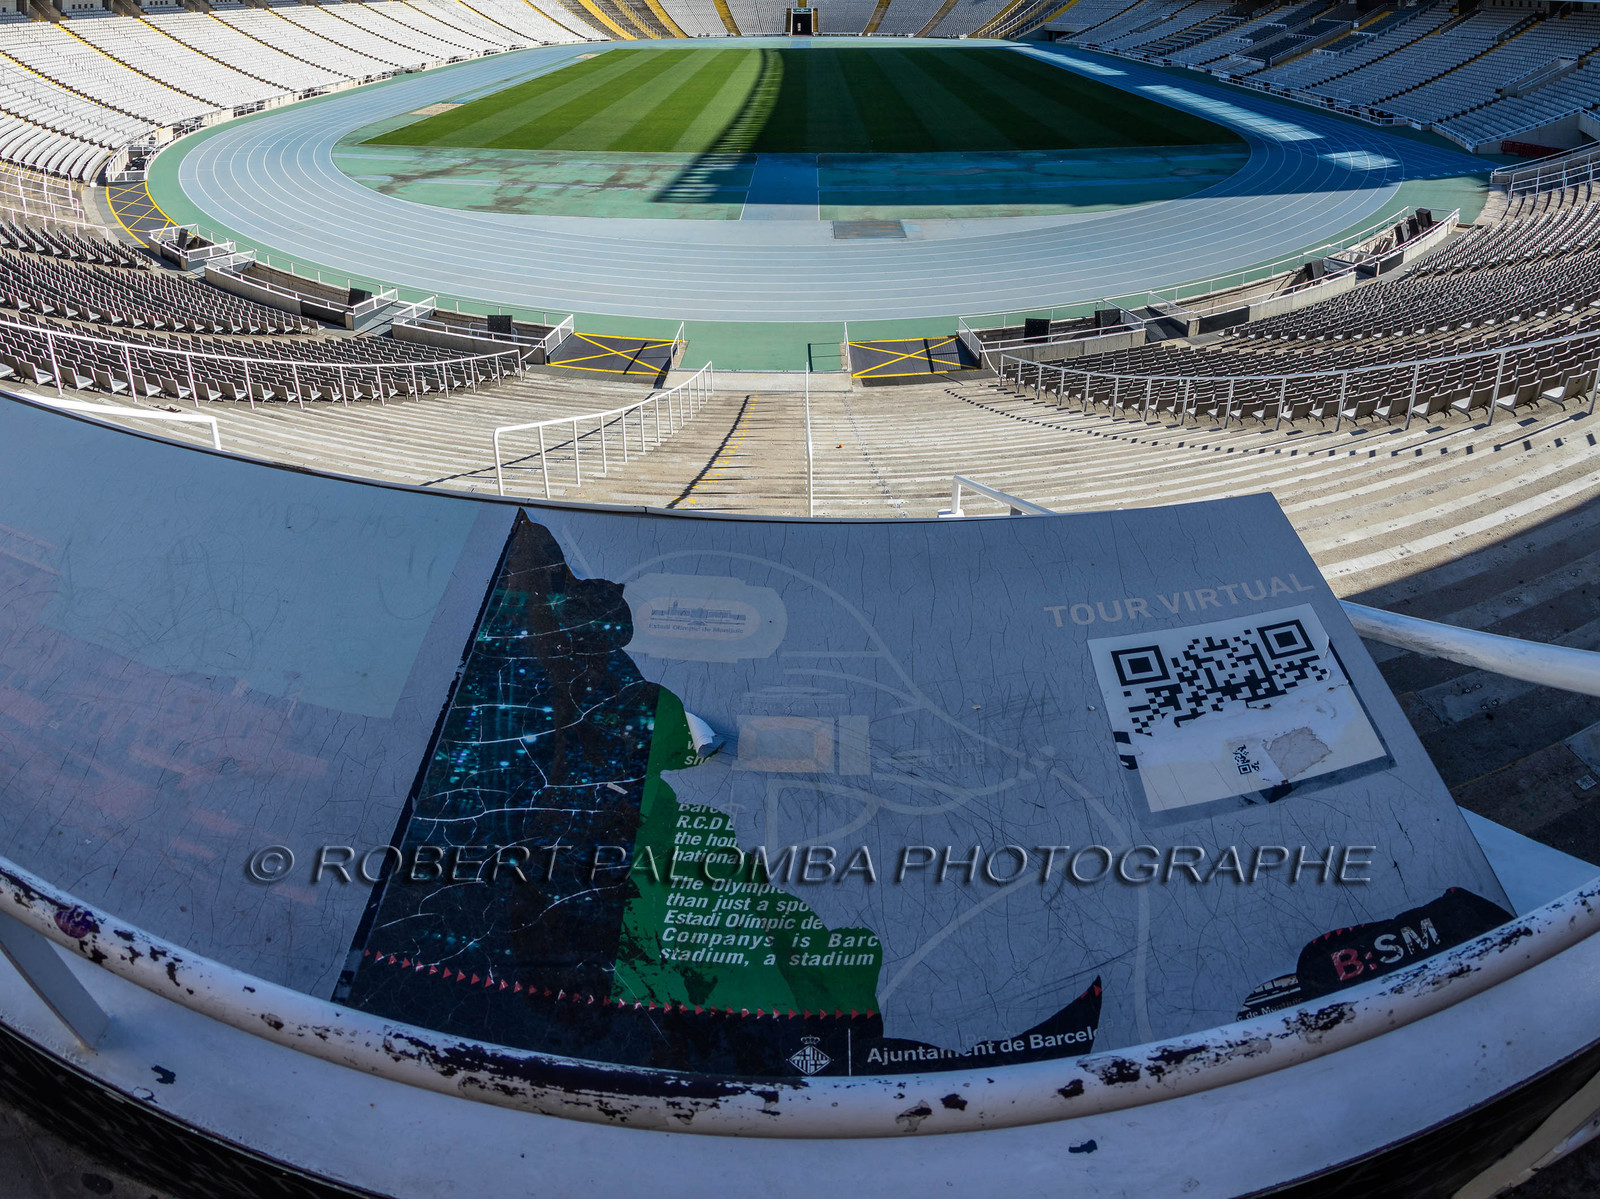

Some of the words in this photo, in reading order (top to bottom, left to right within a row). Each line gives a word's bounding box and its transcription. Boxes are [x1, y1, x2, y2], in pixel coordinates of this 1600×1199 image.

[1043, 597, 1152, 627] TOUR
[1156, 573, 1315, 614] VIRTUAL
[674, 831, 702, 846] the
[670, 876, 704, 890] The
[666, 892, 709, 909] than
[712, 894, 751, 912] just
[756, 900, 769, 911] a
[776, 899, 815, 916] spo
[664, 909, 721, 927] Estadi
[725, 913, 796, 932] Olímpic
[800, 914, 824, 930] de
[662, 927, 775, 950] Companys
[792, 932, 811, 947] is
[827, 933, 880, 948] Barc
[1330, 917, 1441, 982] B:SM
[659, 947, 750, 967] stadium,
[763, 954, 776, 966] a
[788, 950, 874, 967] stadium
[1000, 1038, 1025, 1053] de
